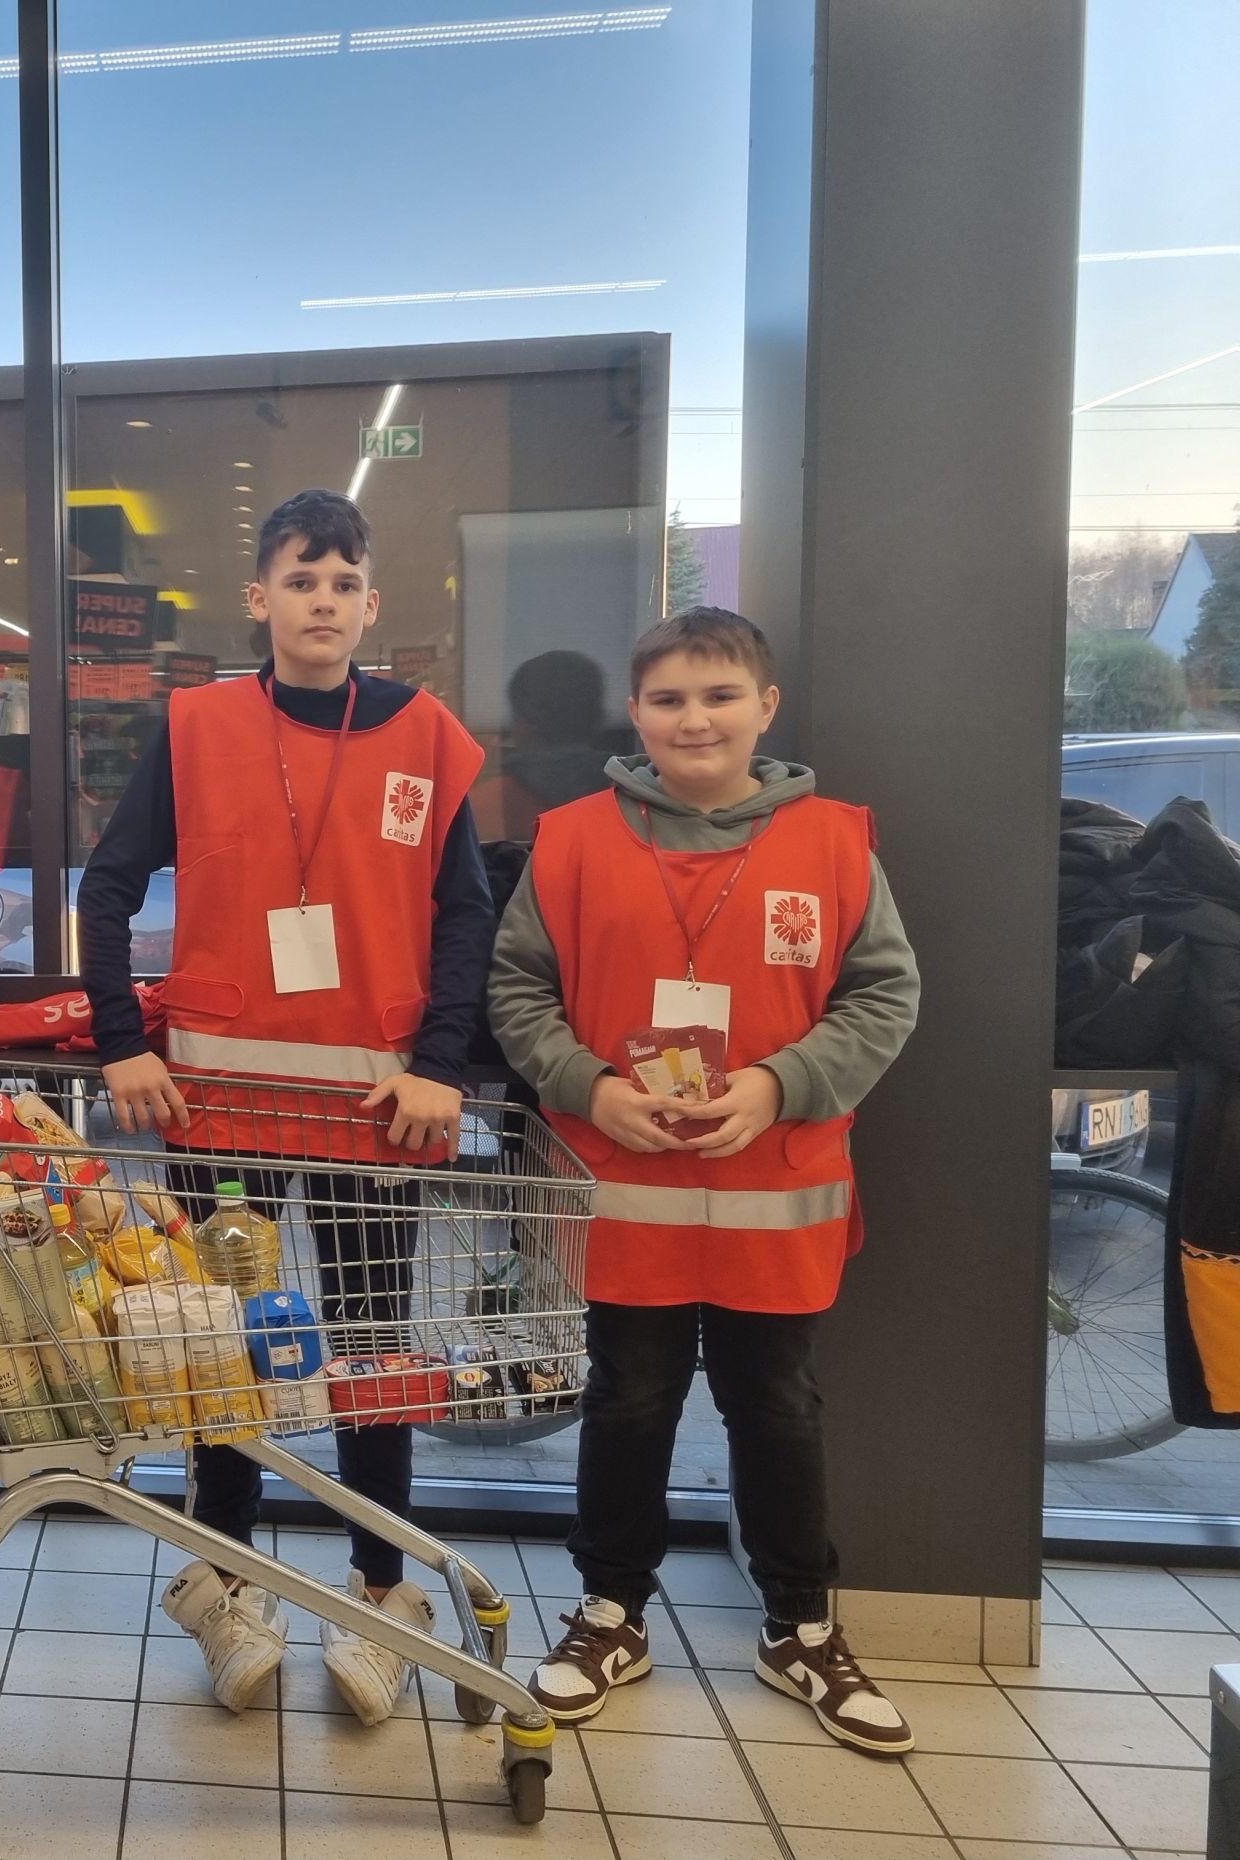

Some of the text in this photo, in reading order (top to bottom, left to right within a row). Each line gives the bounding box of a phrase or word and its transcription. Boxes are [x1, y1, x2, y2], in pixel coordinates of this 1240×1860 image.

[1092, 1104, 1124, 1141] RNI
[170, 1578, 189, 1598] FILA
[420, 1599, 435, 1621] FILA
